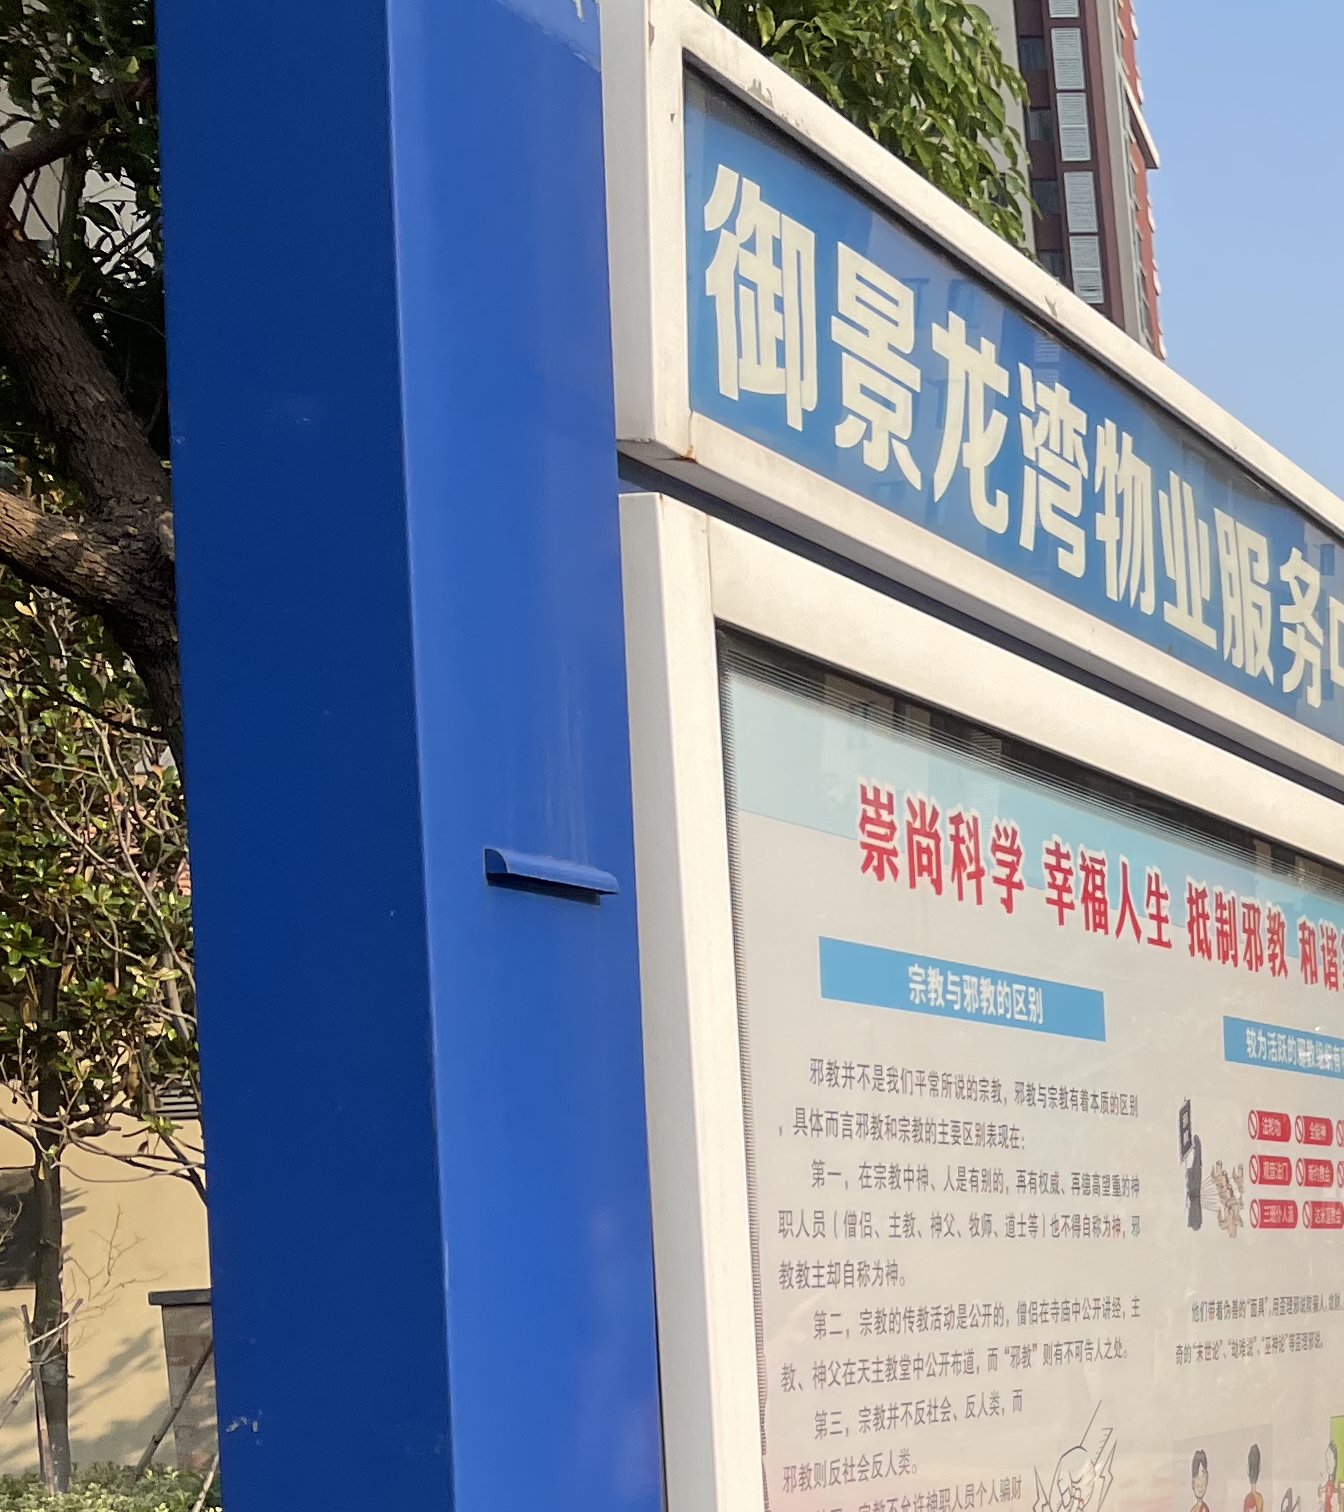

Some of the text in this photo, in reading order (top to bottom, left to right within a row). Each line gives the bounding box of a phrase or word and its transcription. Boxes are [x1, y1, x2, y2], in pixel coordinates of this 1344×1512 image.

[857, 783, 1024, 914] 崇尚科学
[1043, 839, 1172, 949] 幸福人生
[1186, 881, 1289, 979] 抵制邪教
[907, 963, 1044, 1025] 宗教与邪教的区别
[779, 1258, 906, 1290] 教教主却自称为神。
